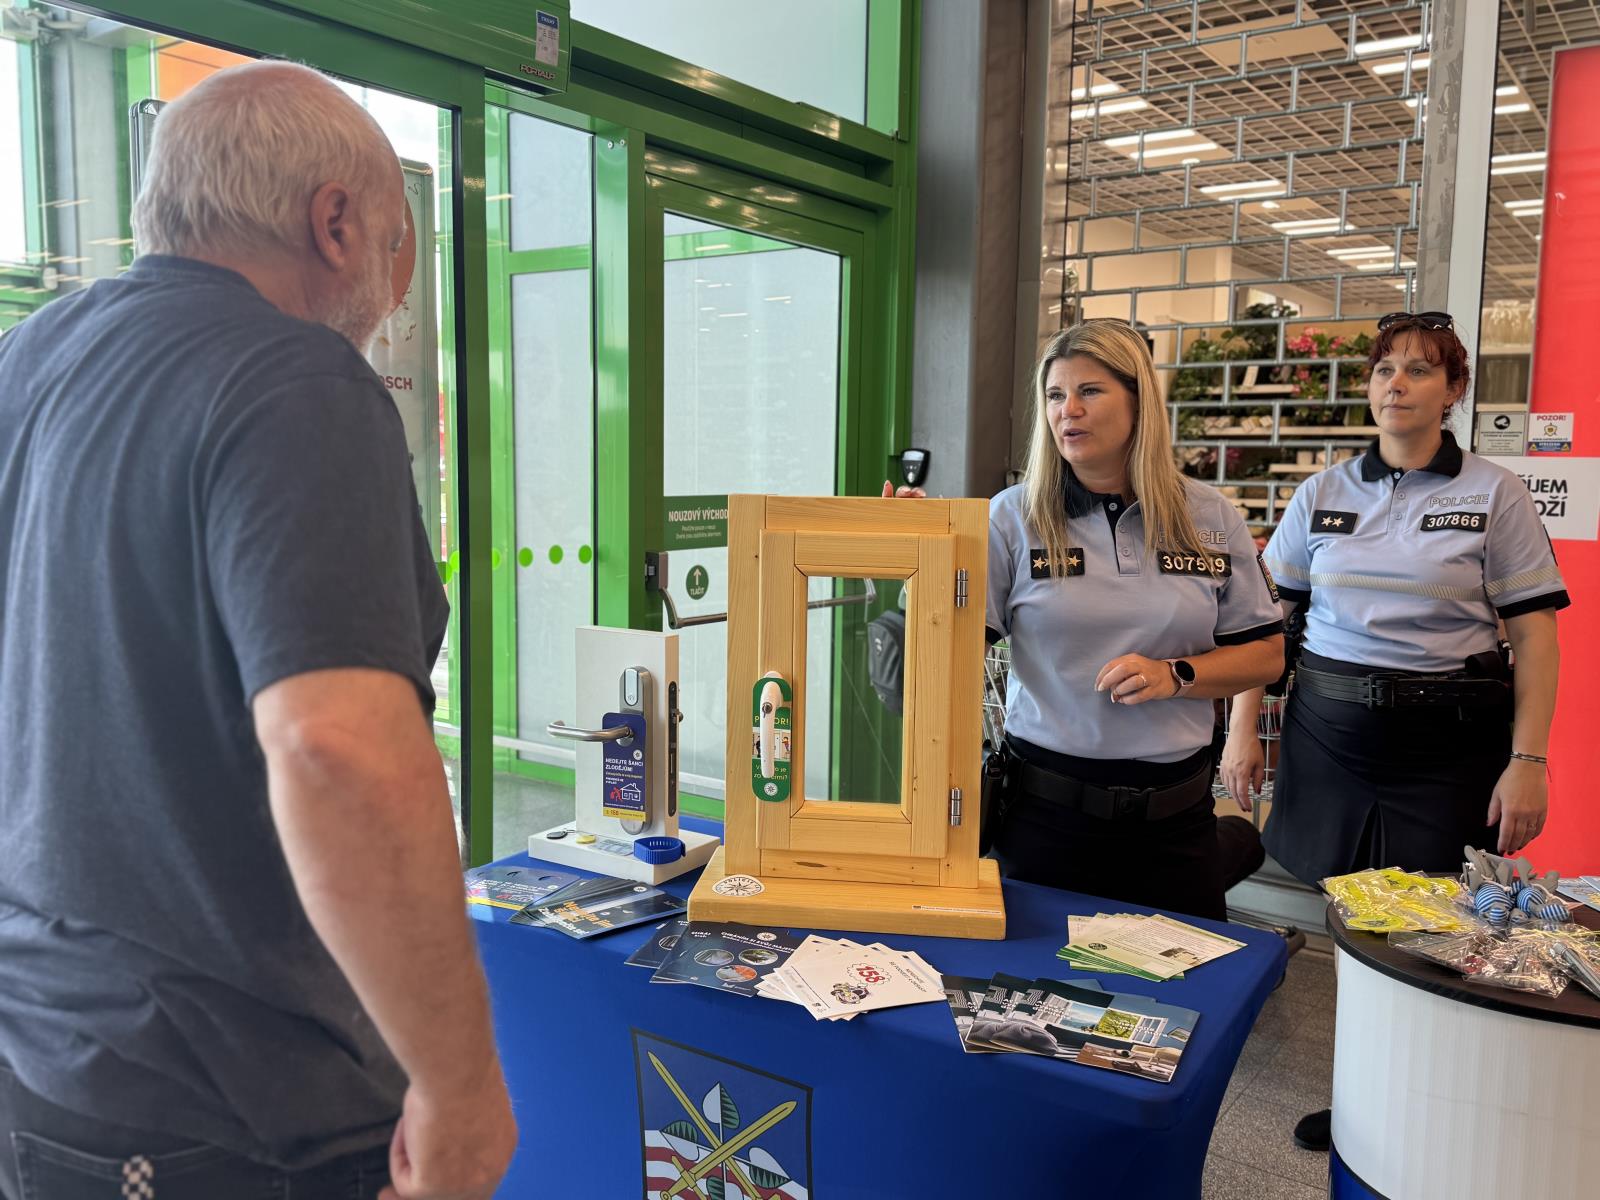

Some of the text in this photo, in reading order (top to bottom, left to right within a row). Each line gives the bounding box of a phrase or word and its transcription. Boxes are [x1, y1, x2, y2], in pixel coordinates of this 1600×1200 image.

[380, 375, 413, 390] SCH
[1518, 474, 1568, 494] ÍJEM
[1429, 493, 1489, 508] POLICIE
[1534, 495, 1568, 517] OŽÍ
[668, 507, 701, 522] NOUZOVÝ
[1427, 514, 1480, 528] 307866
[1160, 530, 1227, 545] PCIE
[754, 715, 789, 725] POR!
[856, 966, 885, 983] 158
